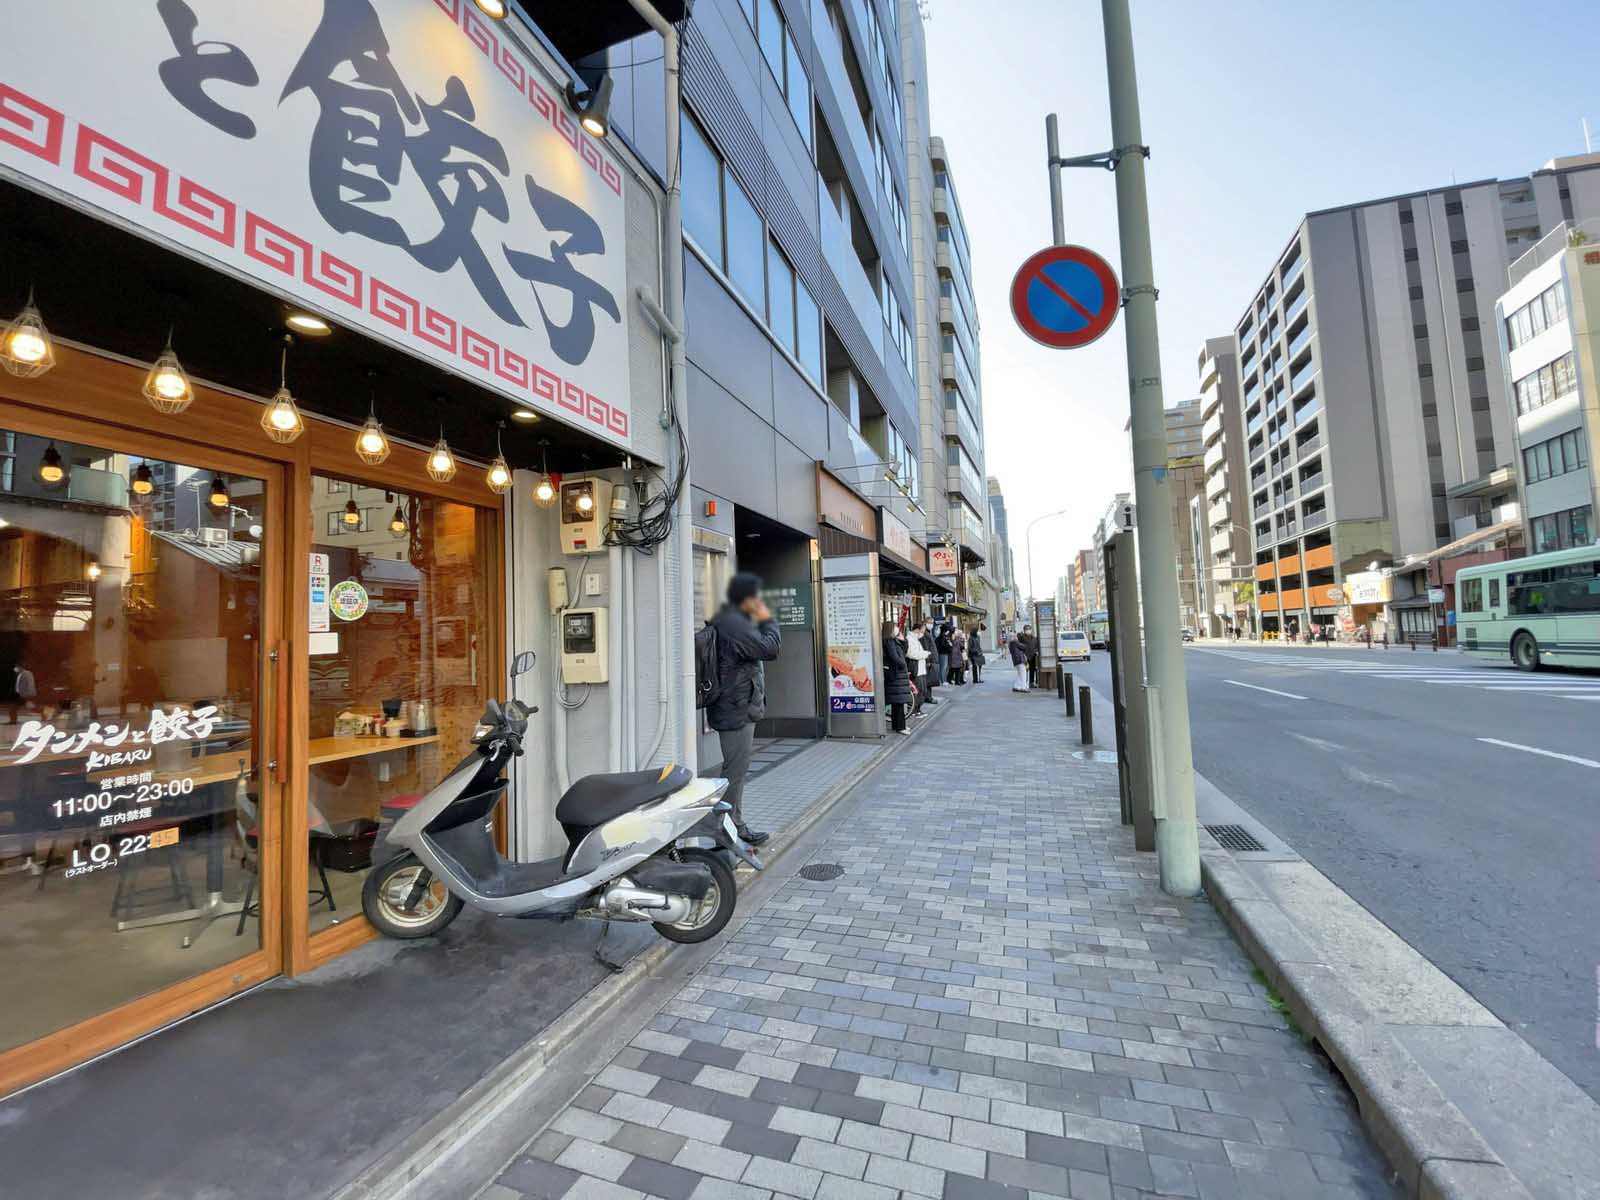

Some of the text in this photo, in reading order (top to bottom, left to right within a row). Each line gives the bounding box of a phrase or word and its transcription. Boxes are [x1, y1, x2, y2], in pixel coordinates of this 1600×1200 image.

[157, 0, 621, 366] と餃子
[945, 593, 954, 603] P
[11, 705, 222, 765] タンメンと餃子
[100, 771, 152, 790] 営業時間
[99, 807, 153, 828] 店内禁煙
